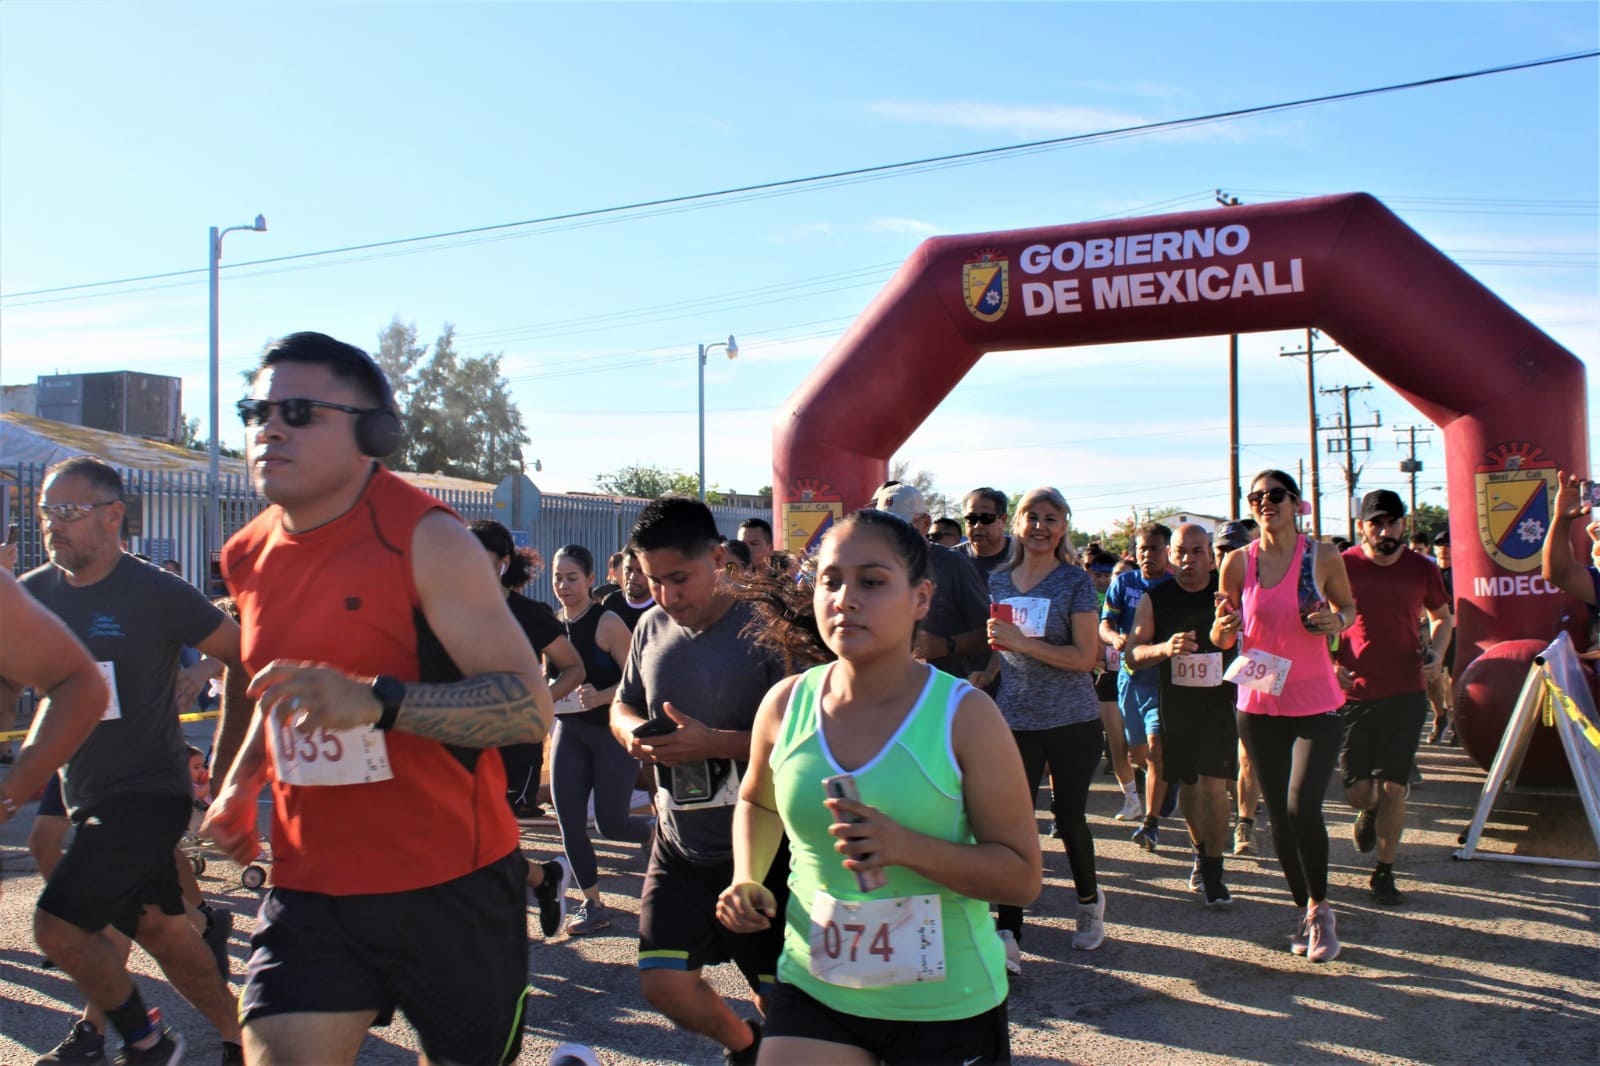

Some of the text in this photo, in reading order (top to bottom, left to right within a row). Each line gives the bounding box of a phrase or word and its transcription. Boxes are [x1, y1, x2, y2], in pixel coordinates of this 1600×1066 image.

[1019, 224, 1250, 274] GOBIERNO
[1021, 258, 1304, 317] DE MEXICALI
[1178, 662, 1208, 679] 019
[1239, 659, 1267, 680] 39
[279, 726, 344, 763] 035
[824, 920, 895, 962] 074
